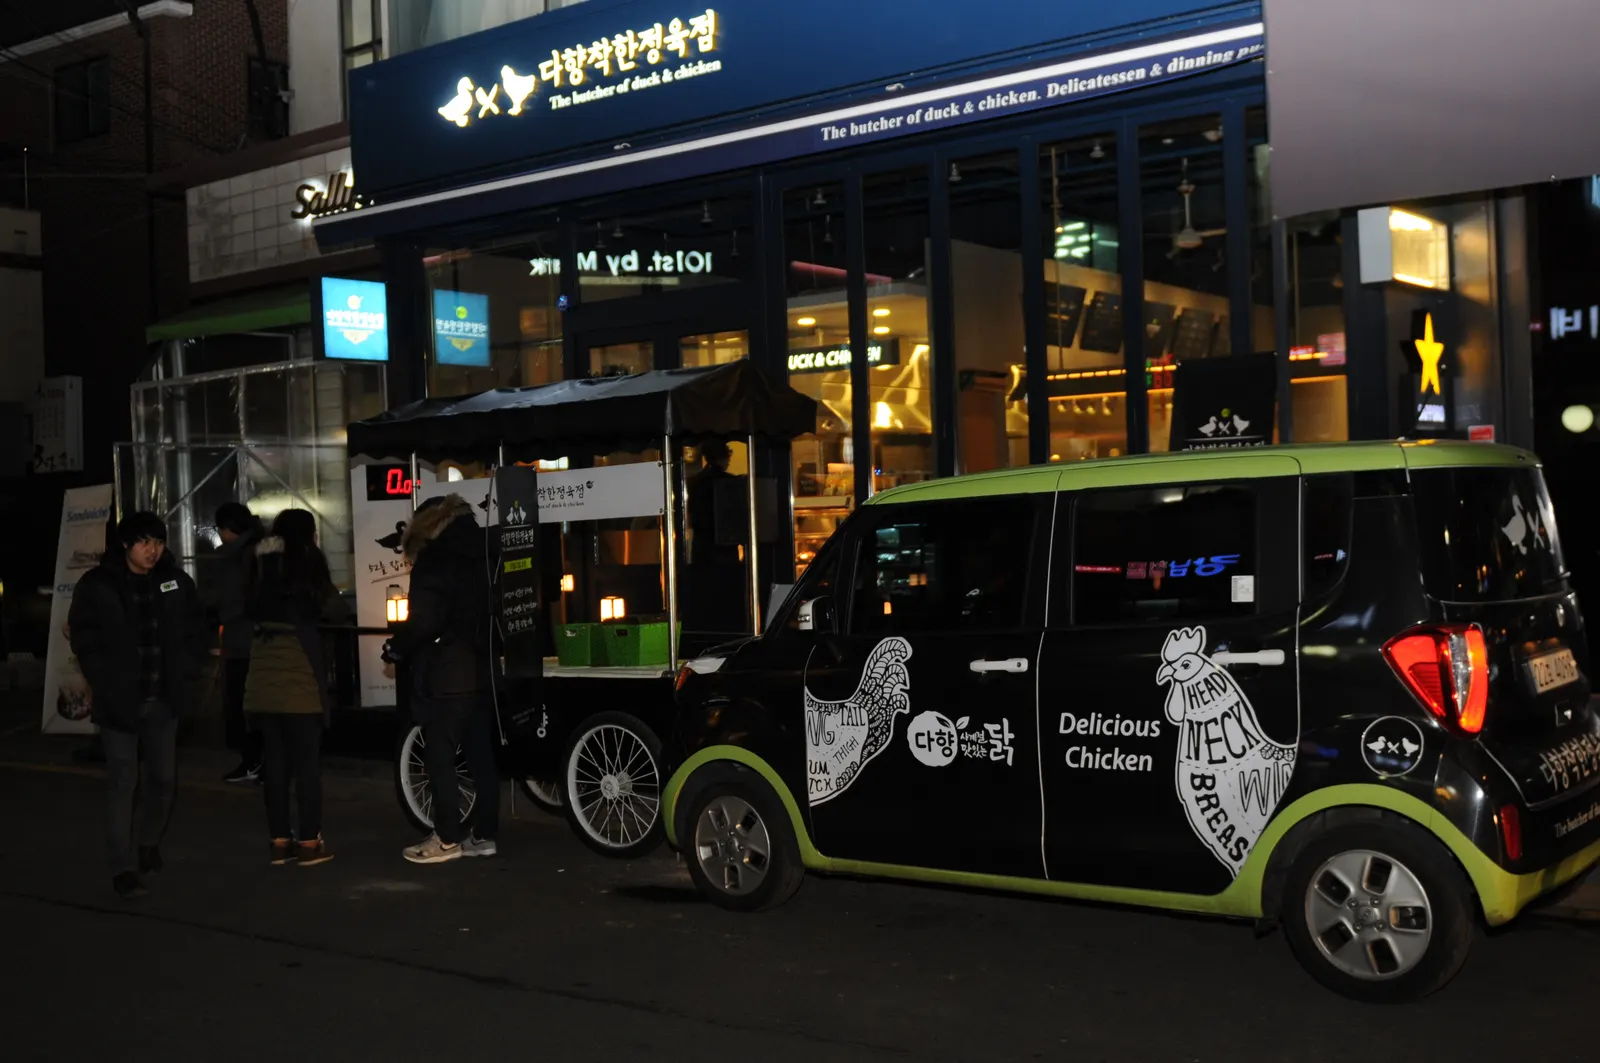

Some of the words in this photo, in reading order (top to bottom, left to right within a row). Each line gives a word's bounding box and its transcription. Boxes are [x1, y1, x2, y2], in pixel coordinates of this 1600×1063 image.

[538, 9, 718, 87] 다향착한정육점
[549, 93, 572, 110] The
[572, 84, 616, 105] butcher
[616, 77, 631, 94] of
[631, 71, 661, 91] duck
[662, 68, 674, 83] &
[674, 60, 722, 80] chicken
[821, 126, 847, 141] The
[850, 115, 904, 136] butcher
[907, 109, 922, 126] of
[924, 102, 960, 121] duck
[963, 101, 974, 114] &
[1046, 67, 1146, 98] Delicatessen
[1149, 63, 1163, 77] &
[1166, 49, 1235, 74] dinning
[787, 353, 814, 370] UCK
[814, 351, 825, 367] &
[1187, 671, 1228, 709] HEAD
[840, 704, 866, 727] TAIL
[1058, 711, 1161, 738] Delicious
[833, 735, 860, 764] THIGH
[914, 728, 956, 757] 다향
[982, 717, 1015, 767] 닭
[1186, 701, 1260, 765] NECK
[960, 742, 988, 759] 맛있는
[1064, 745, 1153, 772] Chicken
[1190, 772, 1250, 864] BREAS
